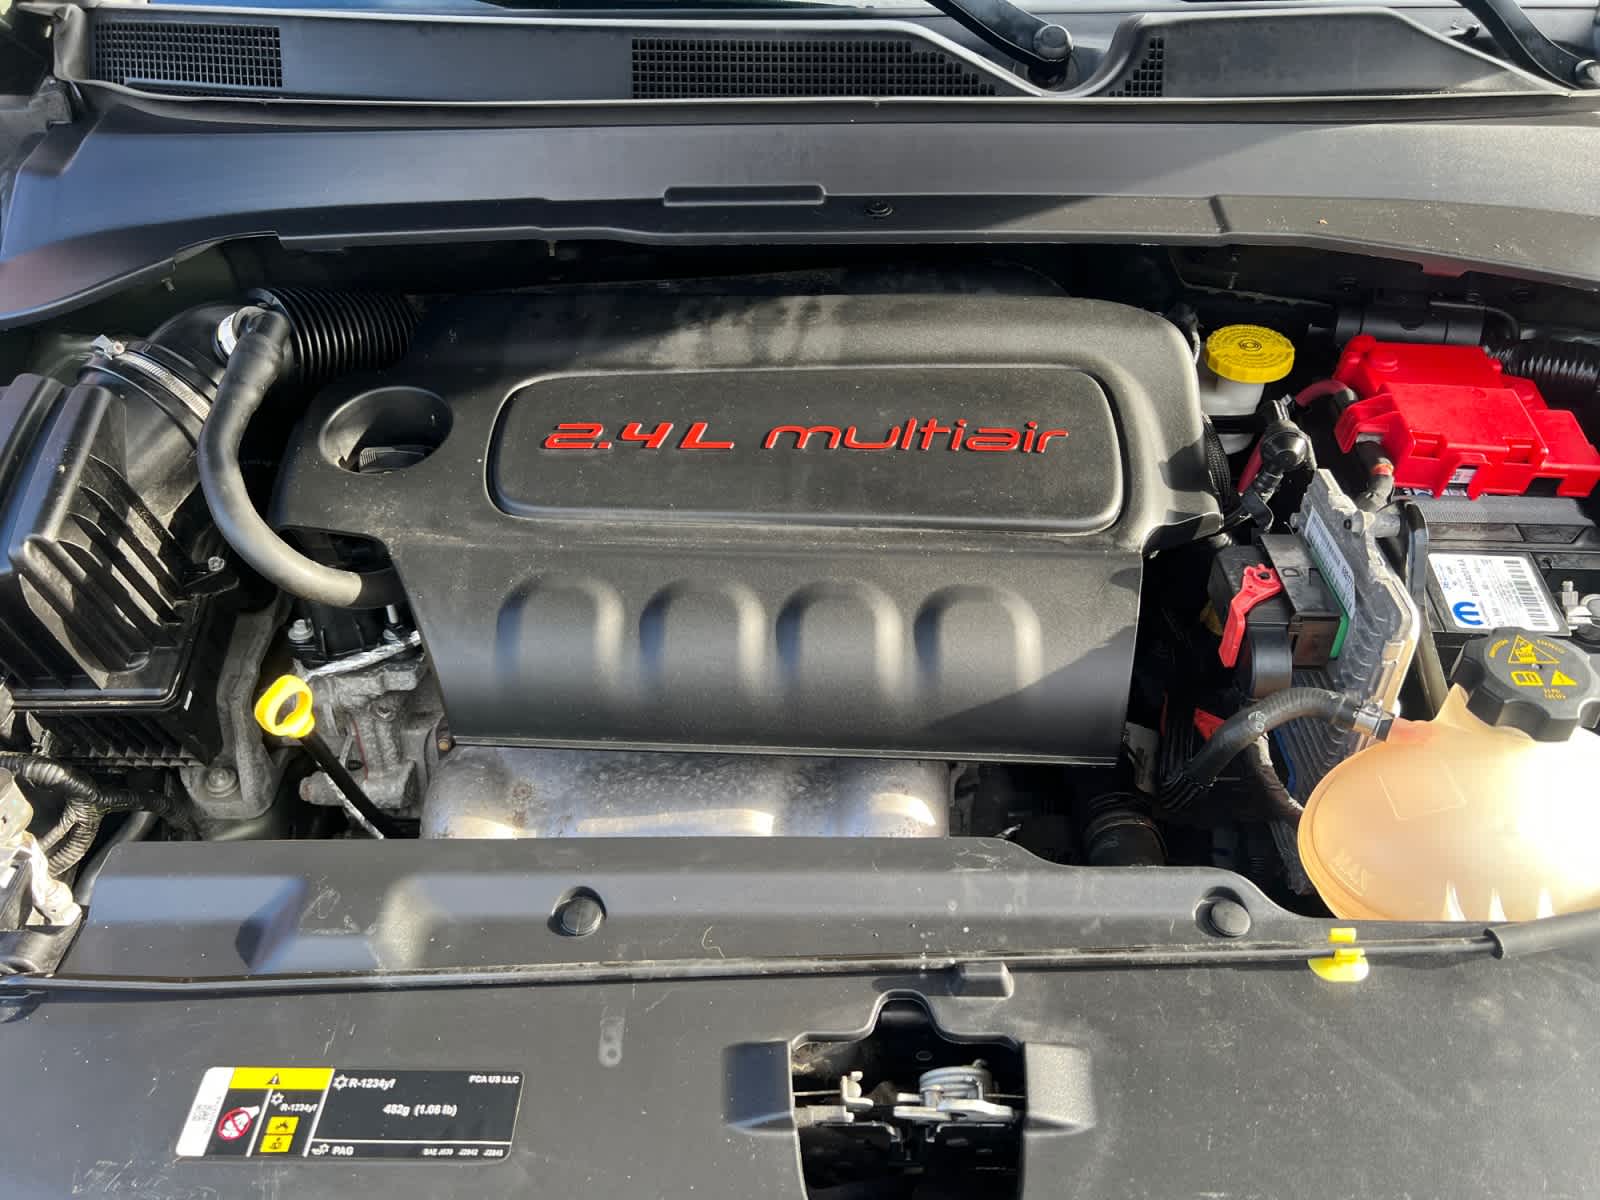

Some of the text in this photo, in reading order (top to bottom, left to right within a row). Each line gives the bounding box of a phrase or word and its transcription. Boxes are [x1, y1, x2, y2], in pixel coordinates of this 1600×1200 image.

[763, 417, 1069, 453] multiair
[348, 1077, 397, 1091] R-1234yf
[468, 1075, 520, 1085] FCA US LLC
[279, 1103, 319, 1113] R-1234yf
[441, 1104, 458, 1117] lb)
[331, 1145, 355, 1156] PAG
